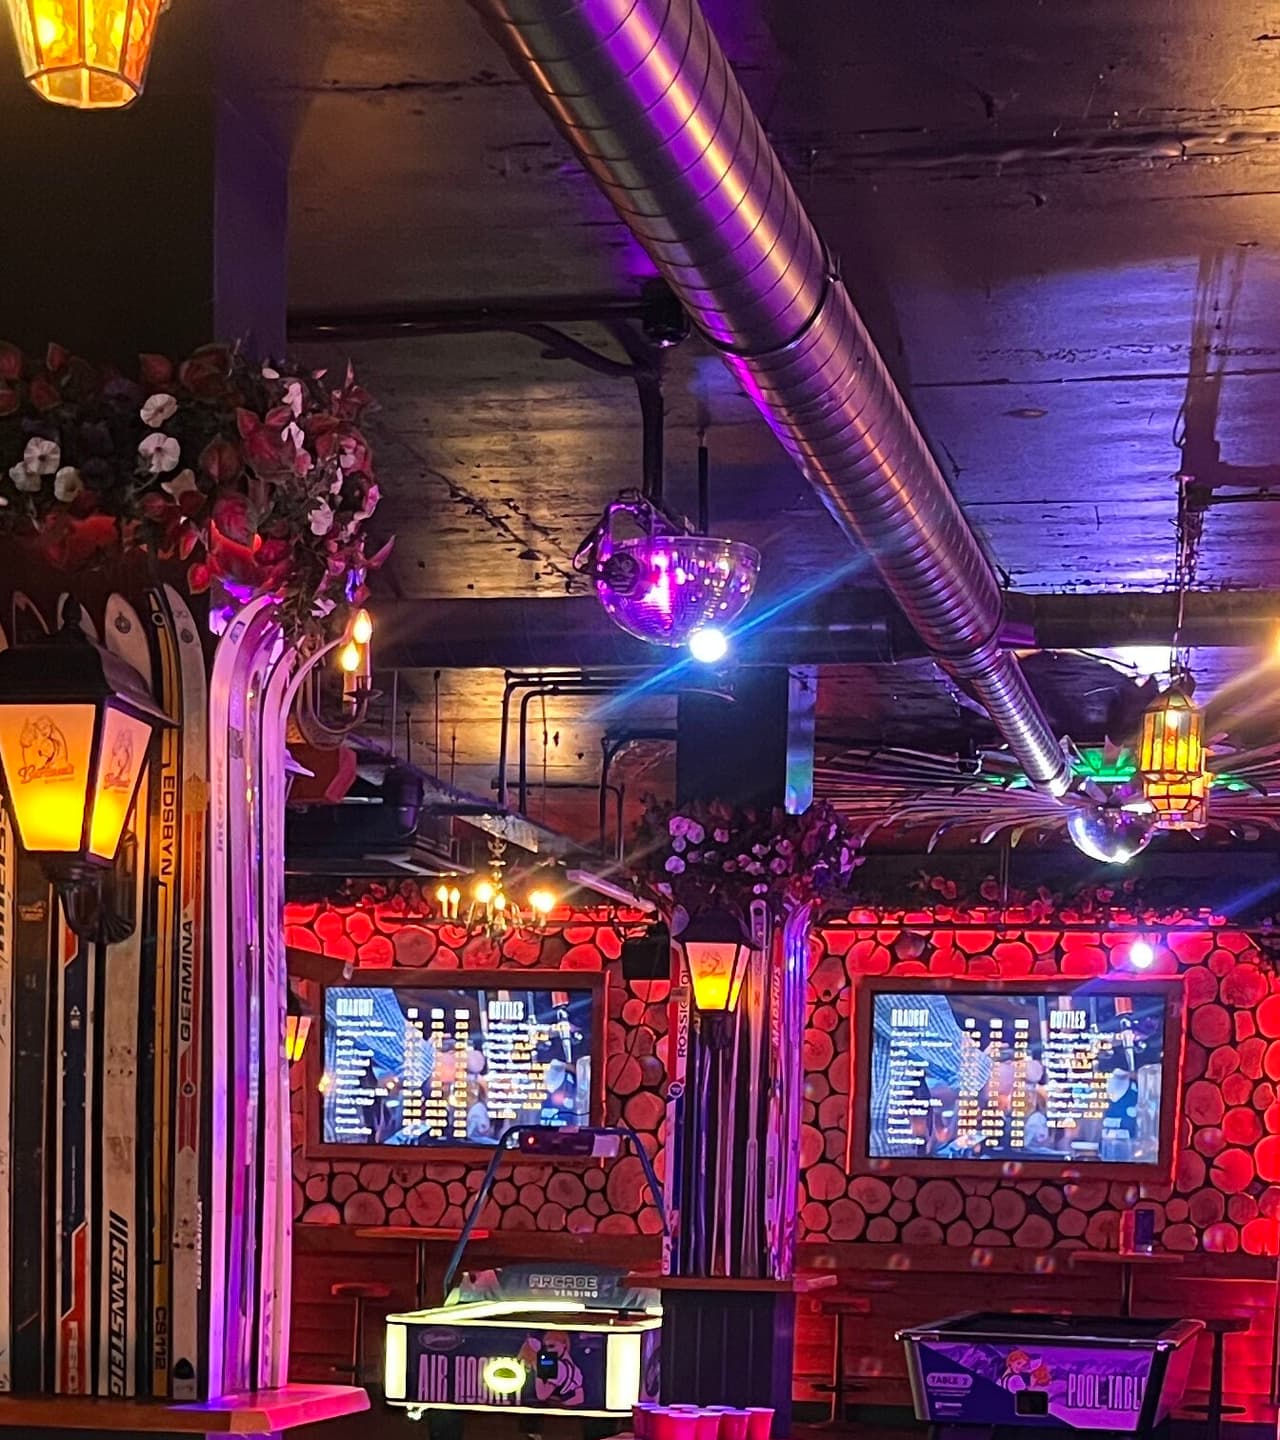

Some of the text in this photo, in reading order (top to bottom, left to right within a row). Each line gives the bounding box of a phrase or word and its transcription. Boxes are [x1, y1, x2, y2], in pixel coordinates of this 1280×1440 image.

[160, 775, 176, 876] EDSBYN
[180, 919, 193, 1042] GERMINA
[772, 966, 783, 1047] MADSHUS
[110, 1237, 129, 1396] RENNSTEIG
[529, 1274, 598, 1289] ARCADE
[418, 1353, 524, 1405] AIR HOC
[1069, 1373, 1099, 1408] POOL
